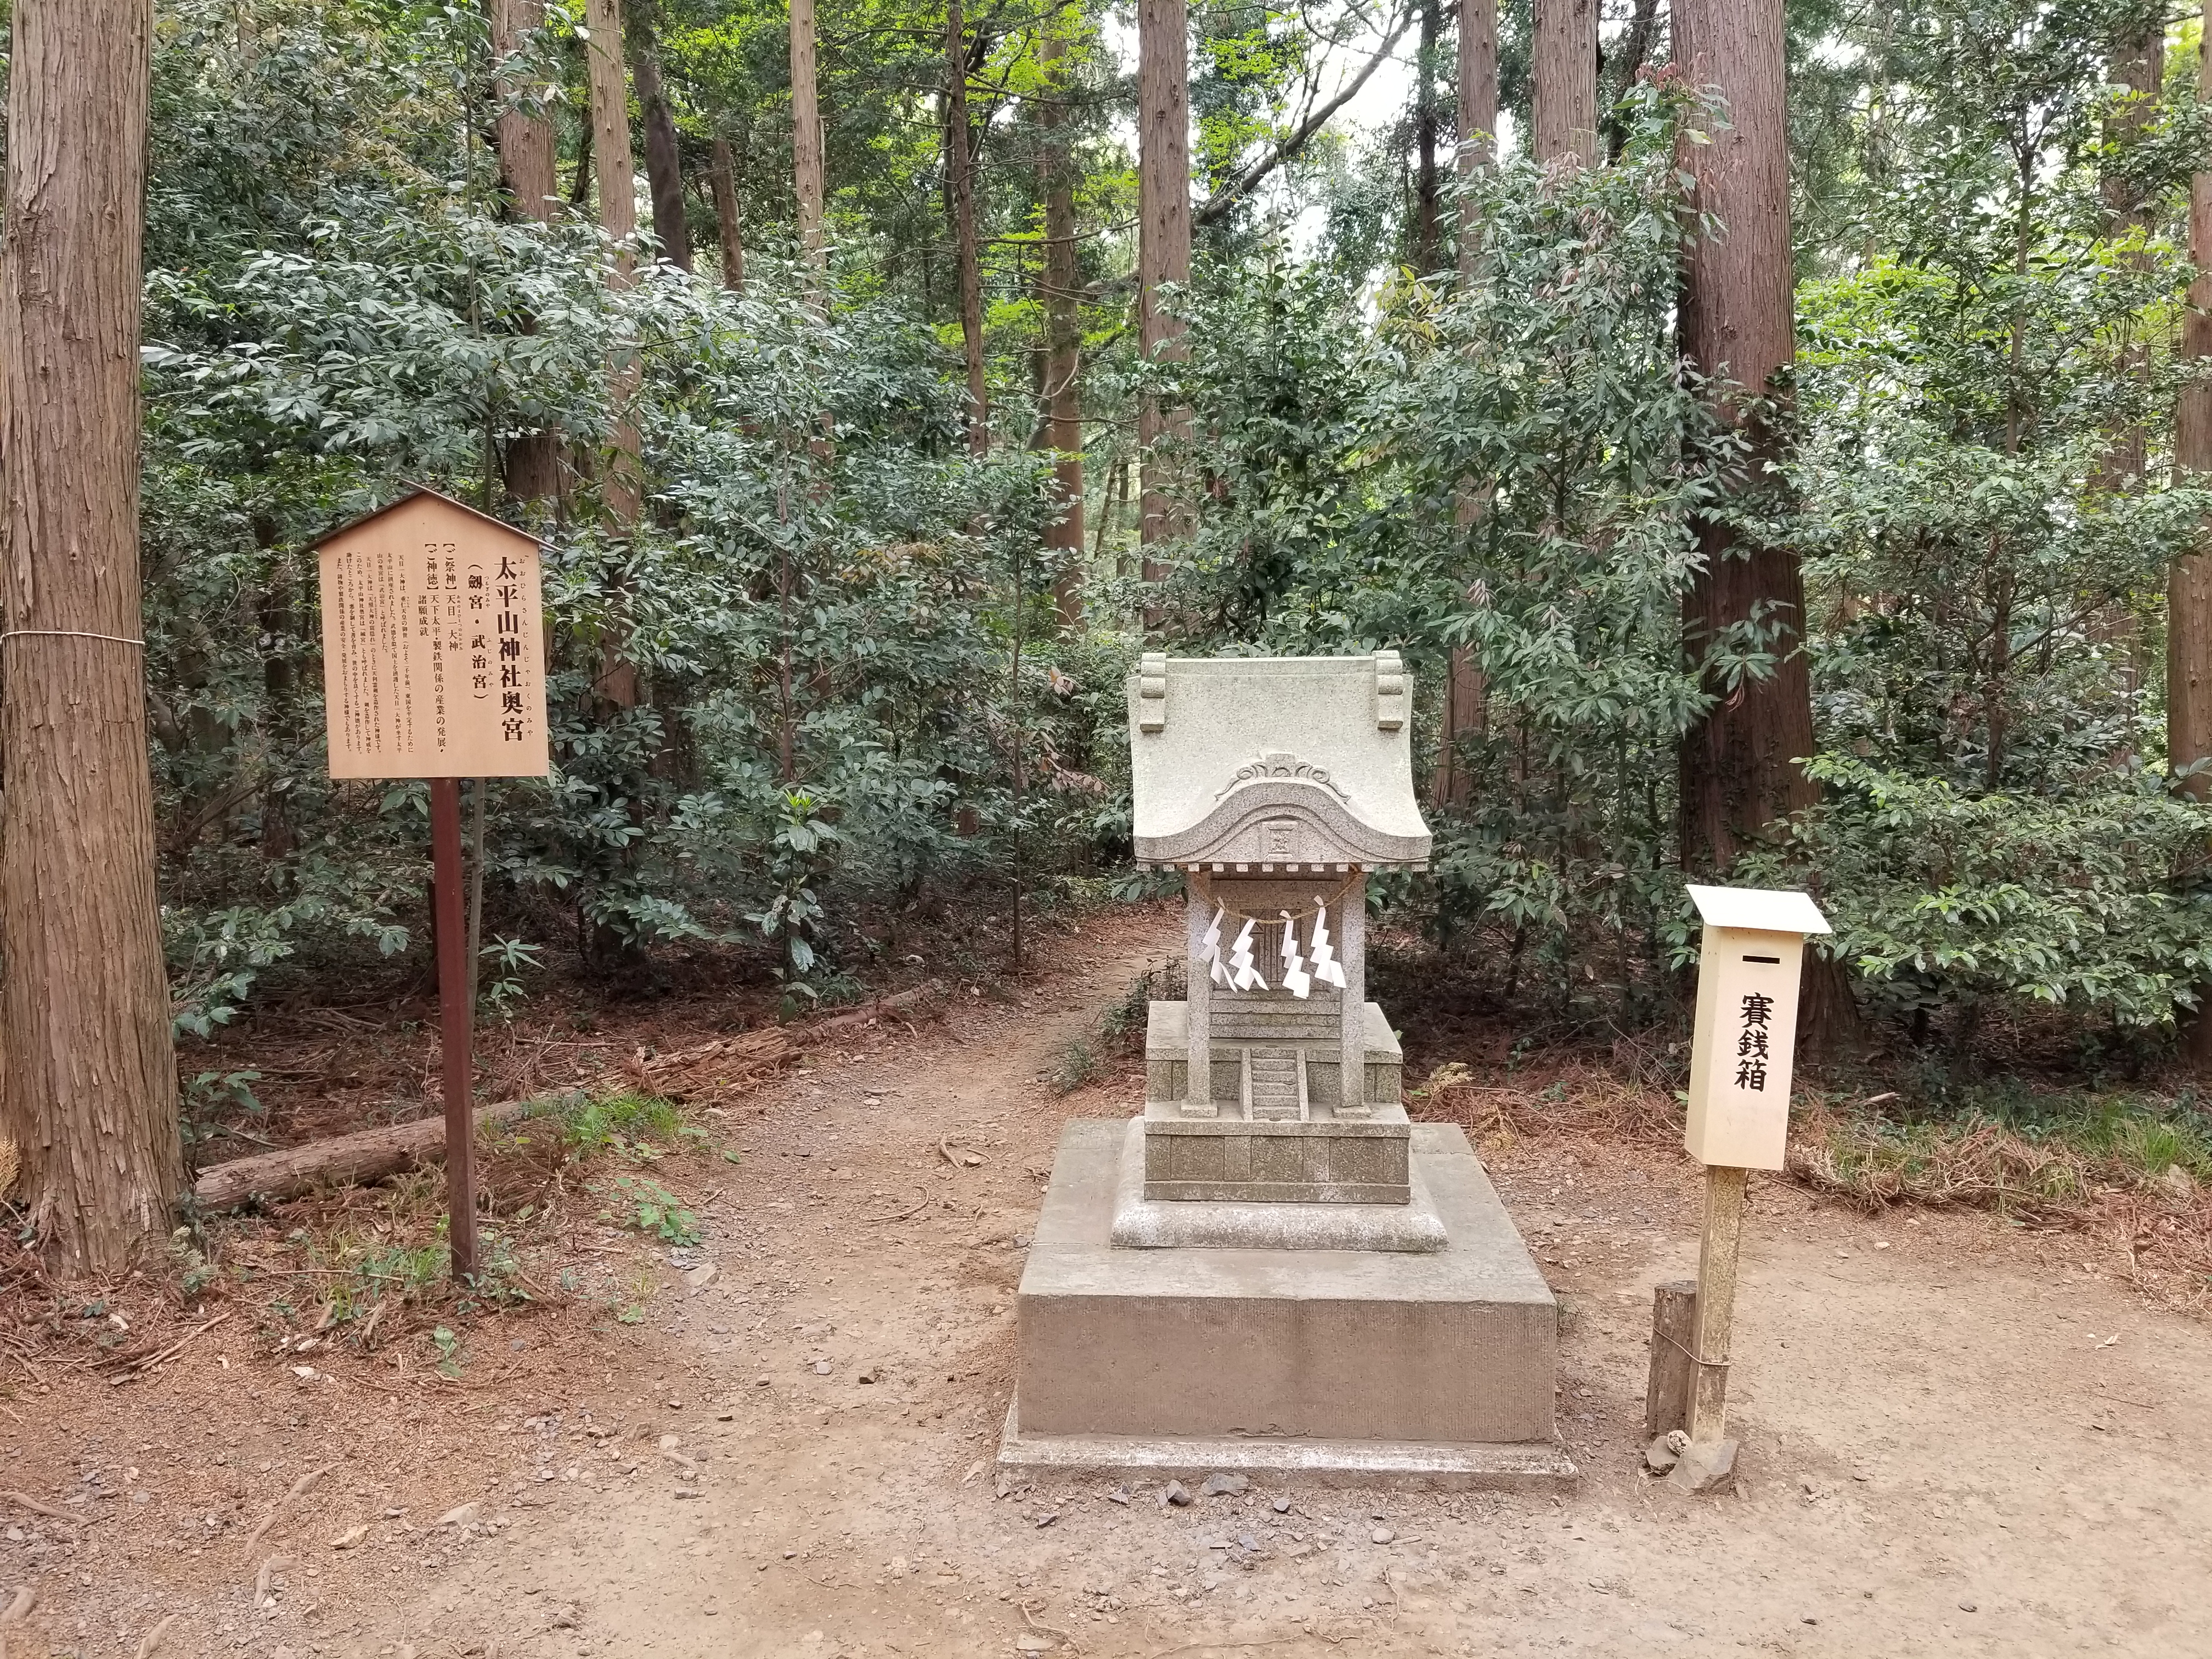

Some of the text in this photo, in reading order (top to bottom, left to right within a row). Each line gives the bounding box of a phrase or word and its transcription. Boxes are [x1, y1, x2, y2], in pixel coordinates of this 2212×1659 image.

[418, 595, 429, 636] 諸願成就
[494, 556, 524, 742] 太平山神社奥宮
[1734, 992, 1775, 1092] 賽銭箱
